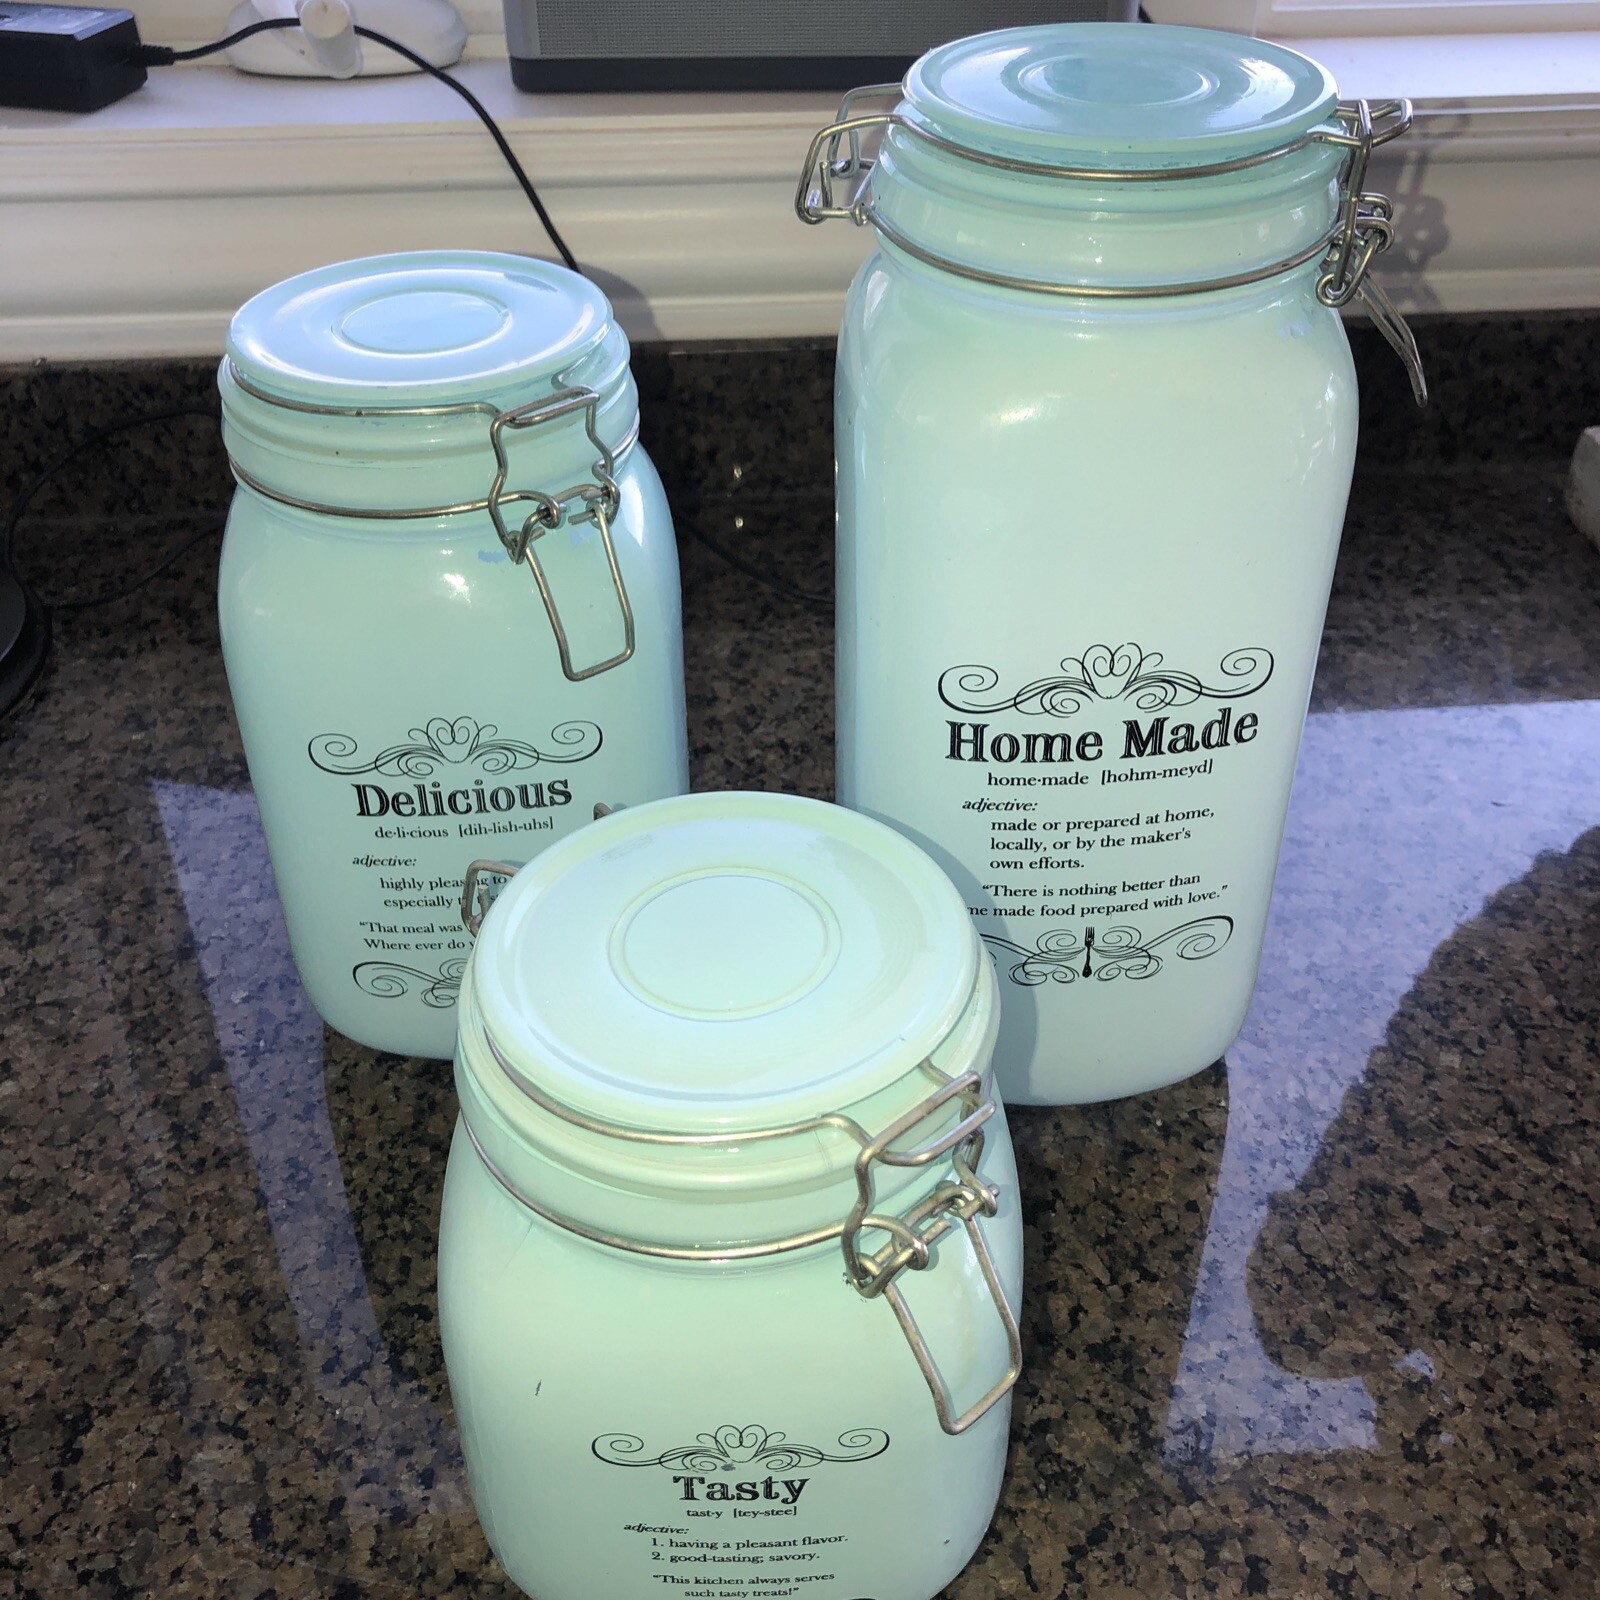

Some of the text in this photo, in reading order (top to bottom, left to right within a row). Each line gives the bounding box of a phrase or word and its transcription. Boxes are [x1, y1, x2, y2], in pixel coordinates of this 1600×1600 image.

[945, 707, 1259, 763] Home Made
[1100, 758, 1213, 785] [hohm-meyd]
[351, 779, 573, 817] Delicious
[961, 797, 1039, 813] adjective:
[990, 807, 1215, 834] made or prepared at home,
[990, 836, 1048, 854] locally,
[1052, 840, 1072, 850] or
[1076, 836, 1097, 852] by
[1100, 834, 1126, 848] the
[351, 854, 417, 868] adjective:
[989, 856, 1085, 870] own efforts.
[379, 877, 425, 892] highly
[492, 874, 508, 885] to
[1041, 884, 1055, 897] is
[1058, 883, 1118, 897] nothing
[1121, 880, 1166, 893] better
[1169, 874, 1201, 888] than
[383, 894, 454, 910] especially
[992, 904, 1036, 917] made
[1040, 903, 1076, 917] food
[1079, 897, 1149, 918] prepared
[1152, 893, 1184, 909] with
[401, 922, 435, 934] meal
[437, 924, 464, 933] was
[363, 937, 412, 951] Where
[414, 942, 444, 951] ever
[447, 938, 466, 950] do
[672, 1474, 810, 1504] Tasty
[733, 1505, 798, 1519] [tey-stee]
[623, 1522, 690, 1535] adjective:
[651, 1535, 849, 1551] 1. having a pleasant flavor.
[651, 1550, 820, 1565] 2. good-tasting; savory.
[693, 1576, 744, 1585] kitchen
[747, 1576, 791, 1586] always
[794, 1573, 836, 1583] serves
[684, 1588, 716, 1598] such
[718, 1590, 750, 1599] tasty
